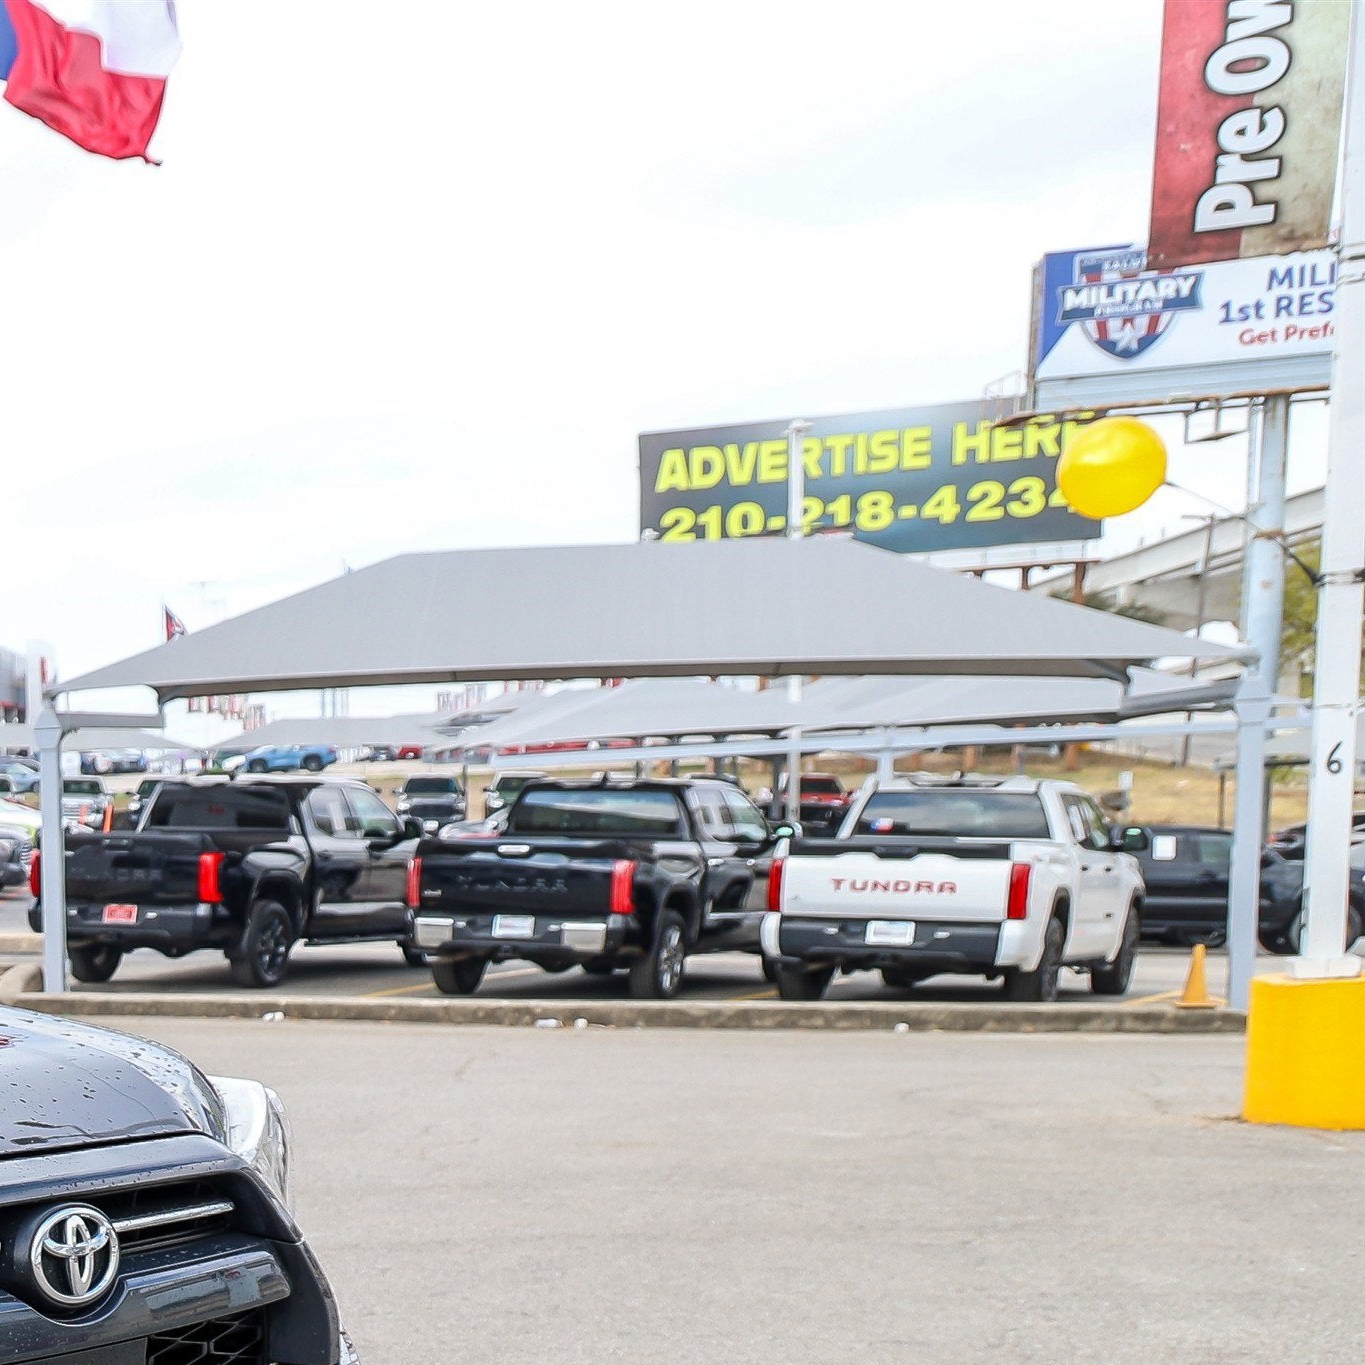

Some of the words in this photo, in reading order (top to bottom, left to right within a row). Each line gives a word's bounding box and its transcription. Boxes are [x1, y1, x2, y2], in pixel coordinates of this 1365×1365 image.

[1194, 105, 1283, 233] Pre
[1062, 274, 1198, 312] MILITARY
[1219, 299, 1266, 324] 1st
[1274, 289, 1336, 319] RES
[1237, 325, 1279, 347] Get
[1284, 320, 1336, 342] Pref
[654, 425, 933, 494] ADVERTISE
[1327, 740, 1342, 774] 6
[831, 877, 959, 895] TUNDRA
